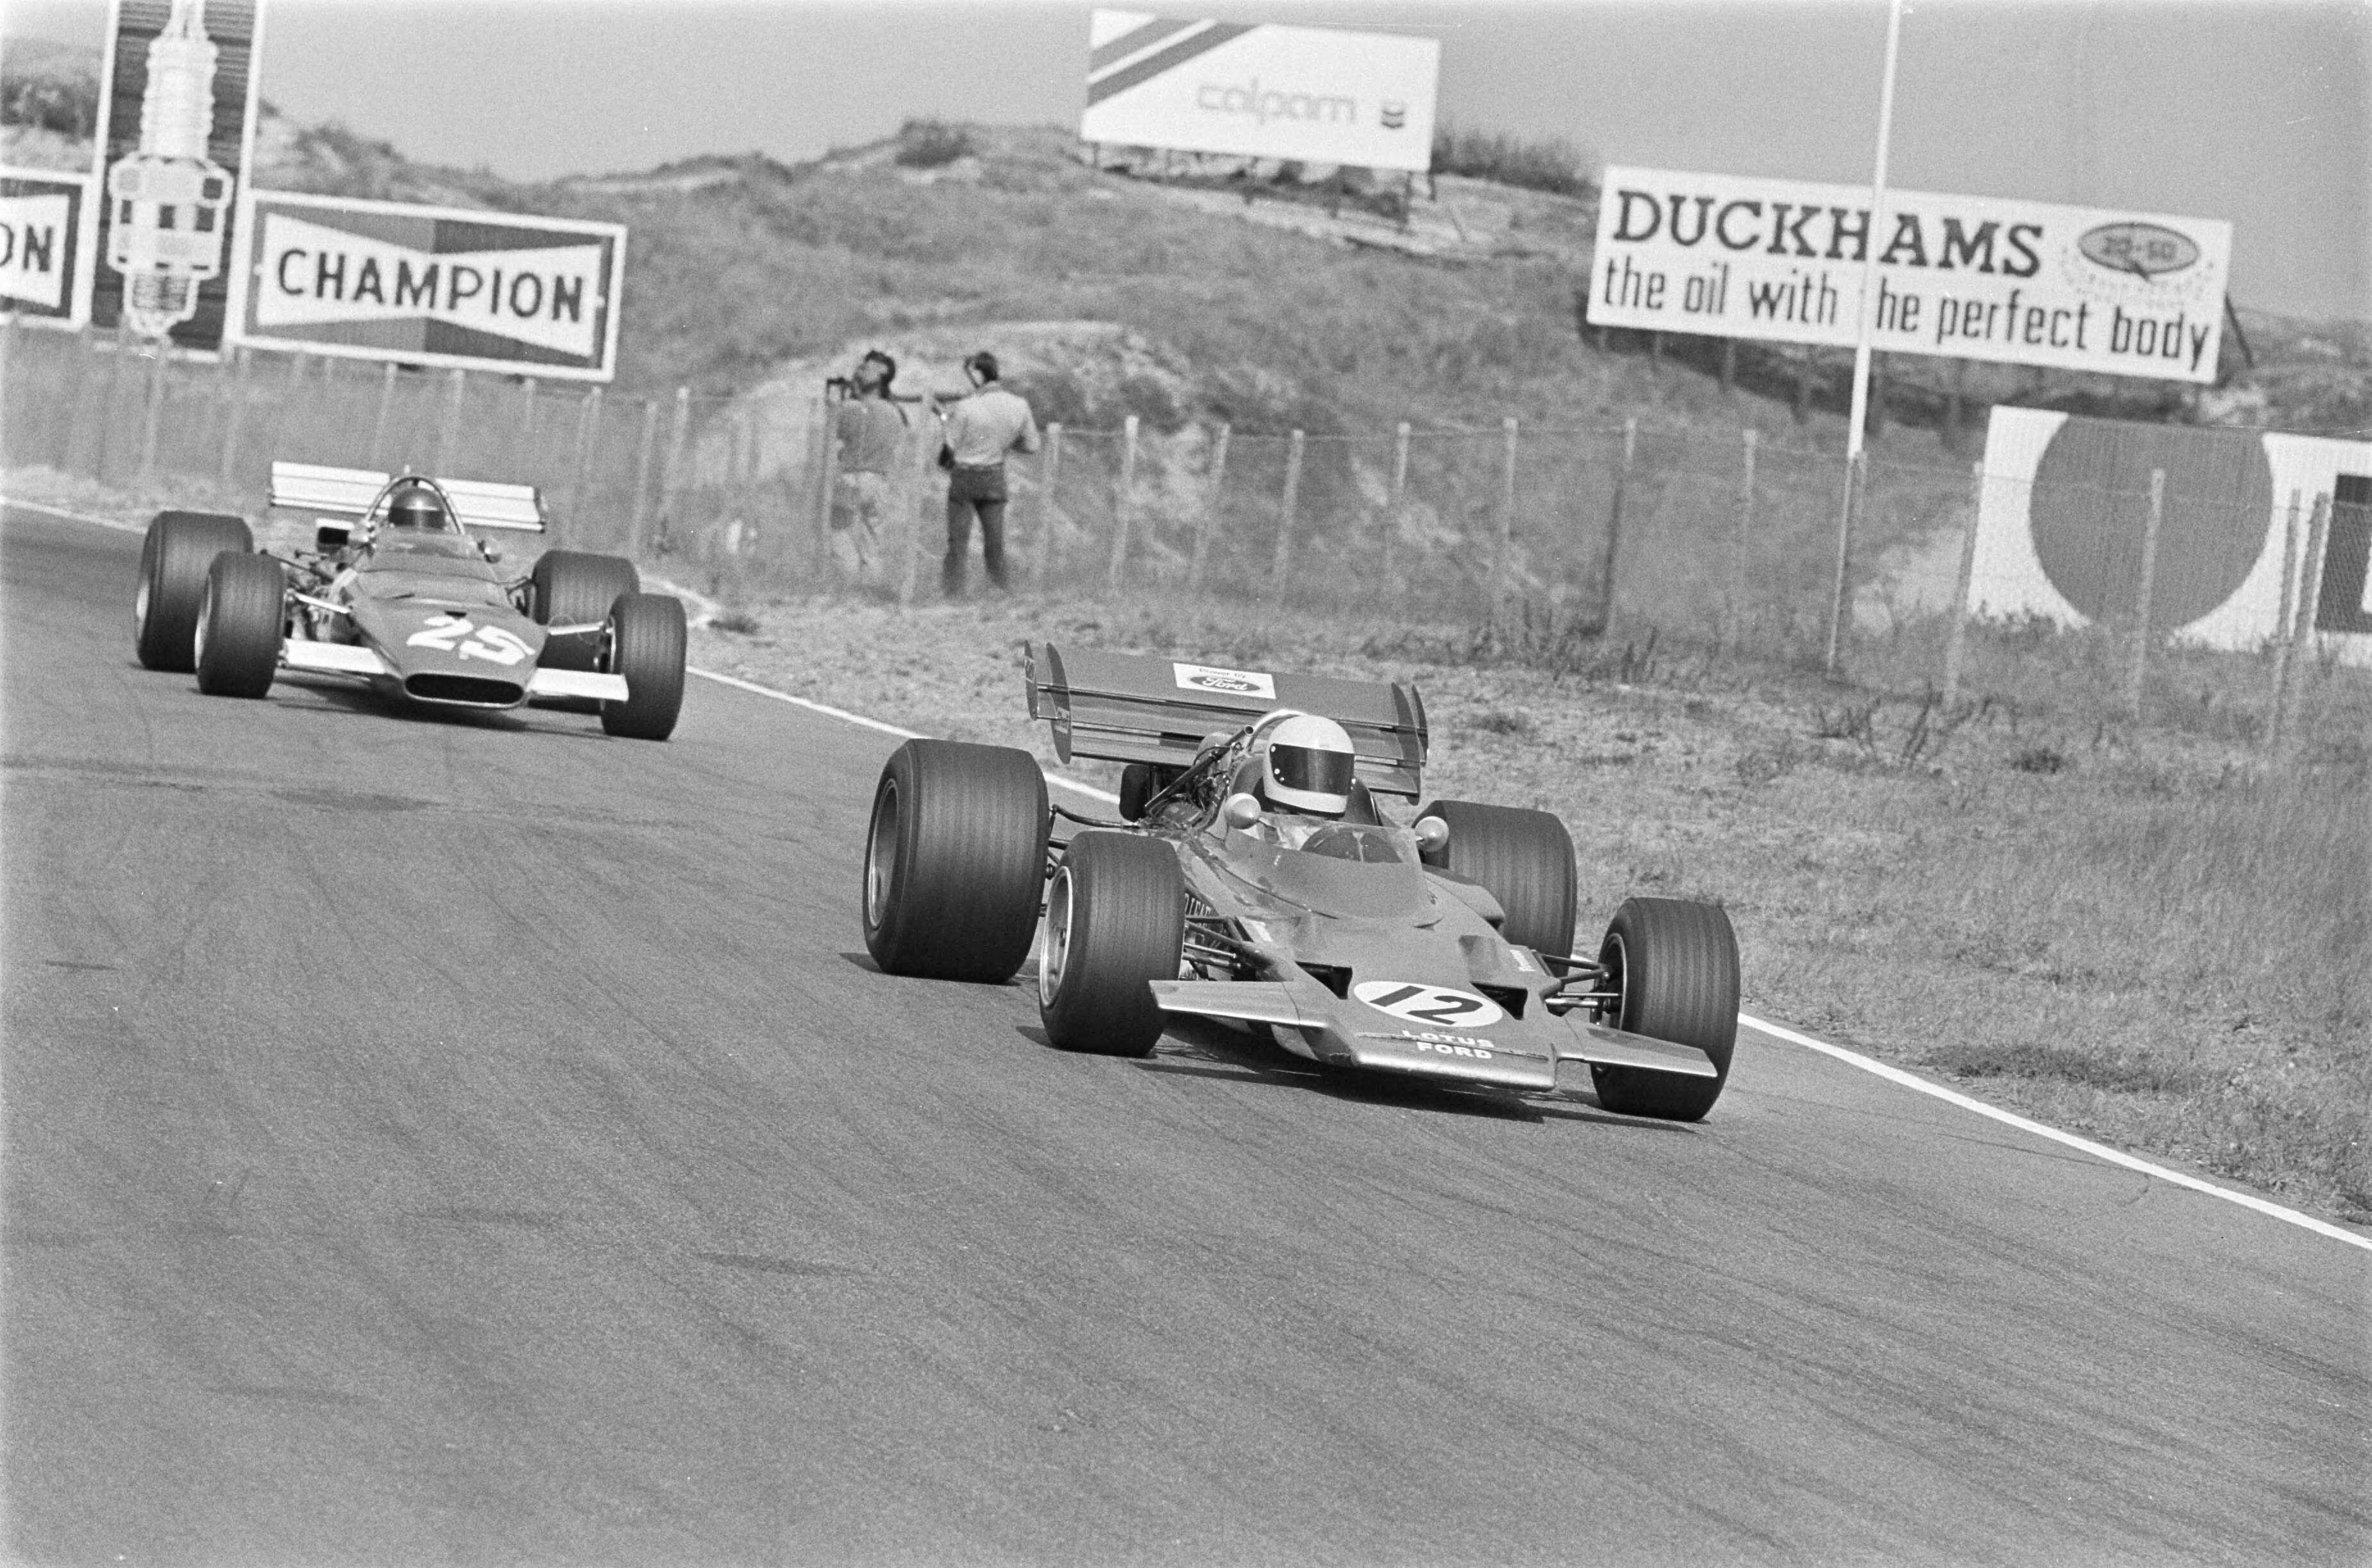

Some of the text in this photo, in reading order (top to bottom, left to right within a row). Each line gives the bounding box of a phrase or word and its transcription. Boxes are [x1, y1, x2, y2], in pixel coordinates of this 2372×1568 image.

[1198, 76, 1357, 126] calpam
[1612, 189, 2044, 279] DUCKHAMS
[278, 248, 583, 323] CHAMPION
[1604, 255, 2210, 373] the oil with he perfect body
[407, 616, 535, 665] 25
[1202, 676, 1249, 691] Ford
[1368, 985, 1483, 1025] 12
[1402, 1030, 1495, 1048] LOTUS
[1416, 1041, 1492, 1059] FORD
